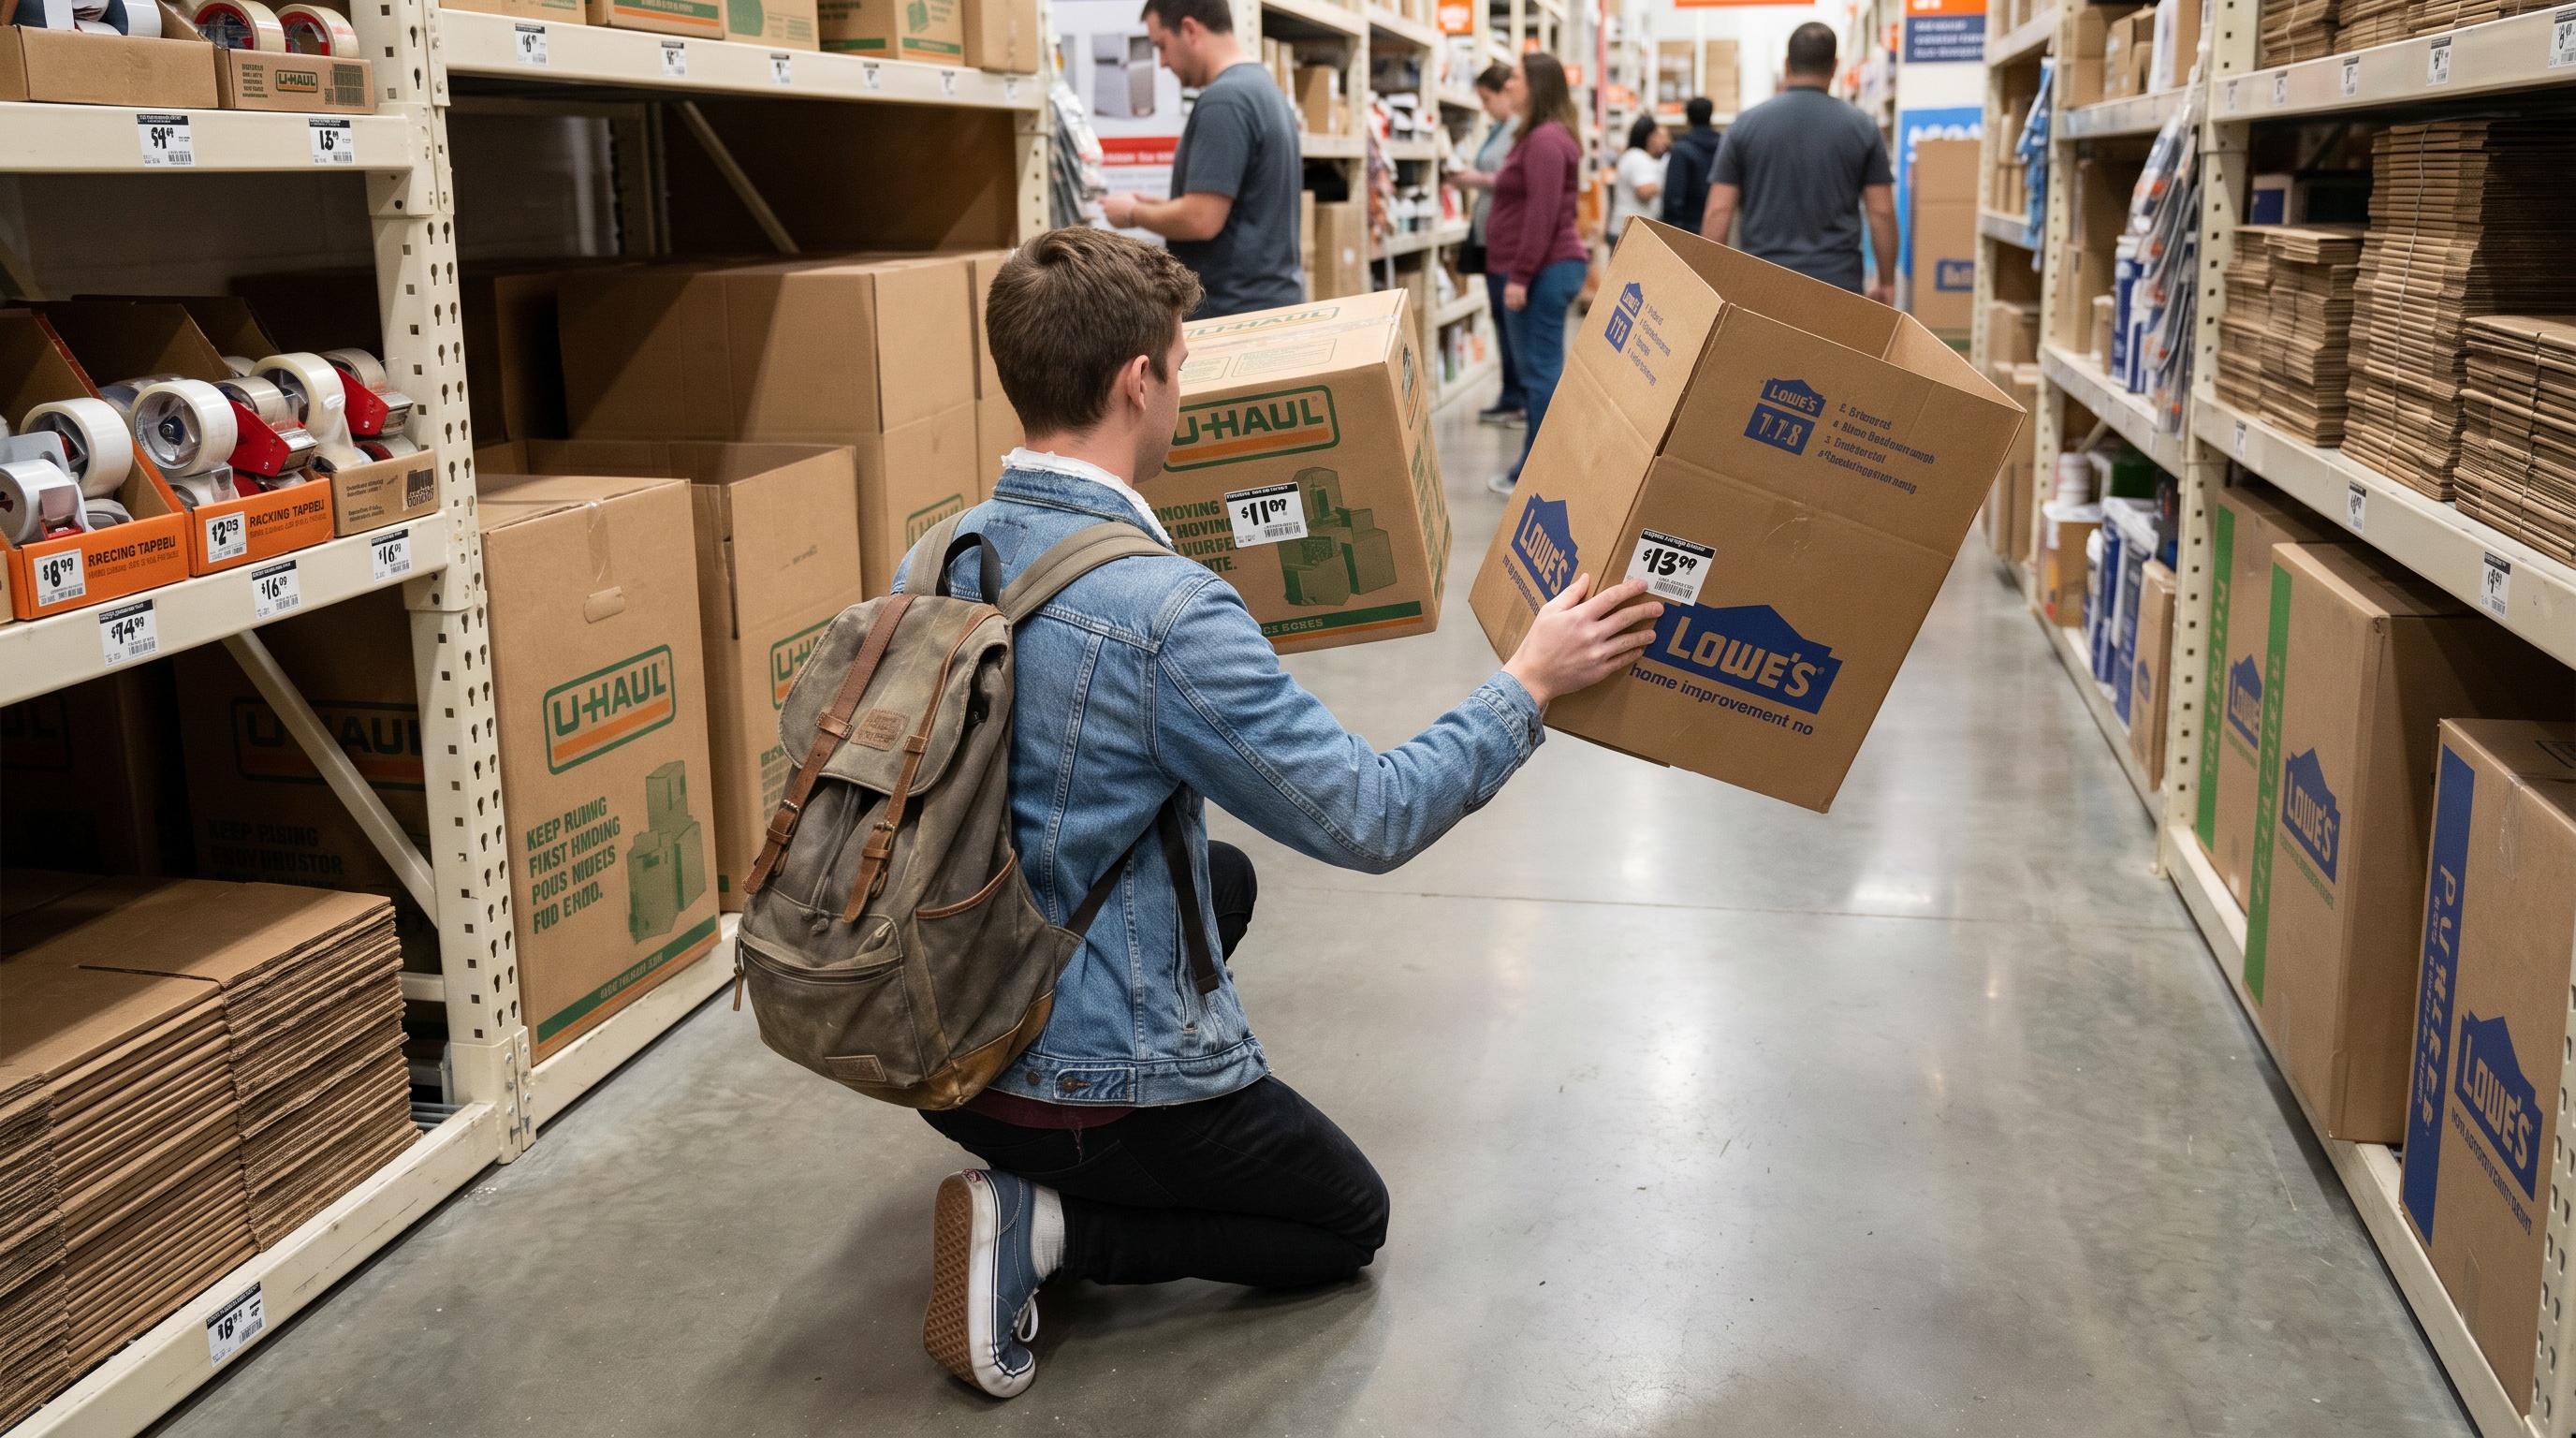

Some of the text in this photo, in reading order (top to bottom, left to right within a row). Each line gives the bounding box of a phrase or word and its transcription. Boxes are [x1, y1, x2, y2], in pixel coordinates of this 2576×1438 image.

[278, 73, 315, 86] U-HAUL
[1192, 312, 1327, 336] U-HAUL
[1171, 398, 1325, 447] U-HAUL
[1769, 384, 1819, 413] LOWE'S
[1519, 508, 1571, 596] LOWE'S
[1666, 615, 1818, 698] LOWE'S
[553, 661, 666, 737] U-HAUL
[1629, 662, 1814, 736] home improvement no
[526, 817, 561, 852] KEEP
[2287, 770, 2336, 863] LOWE'S
[2463, 1033, 2531, 1170] LOWE'S
